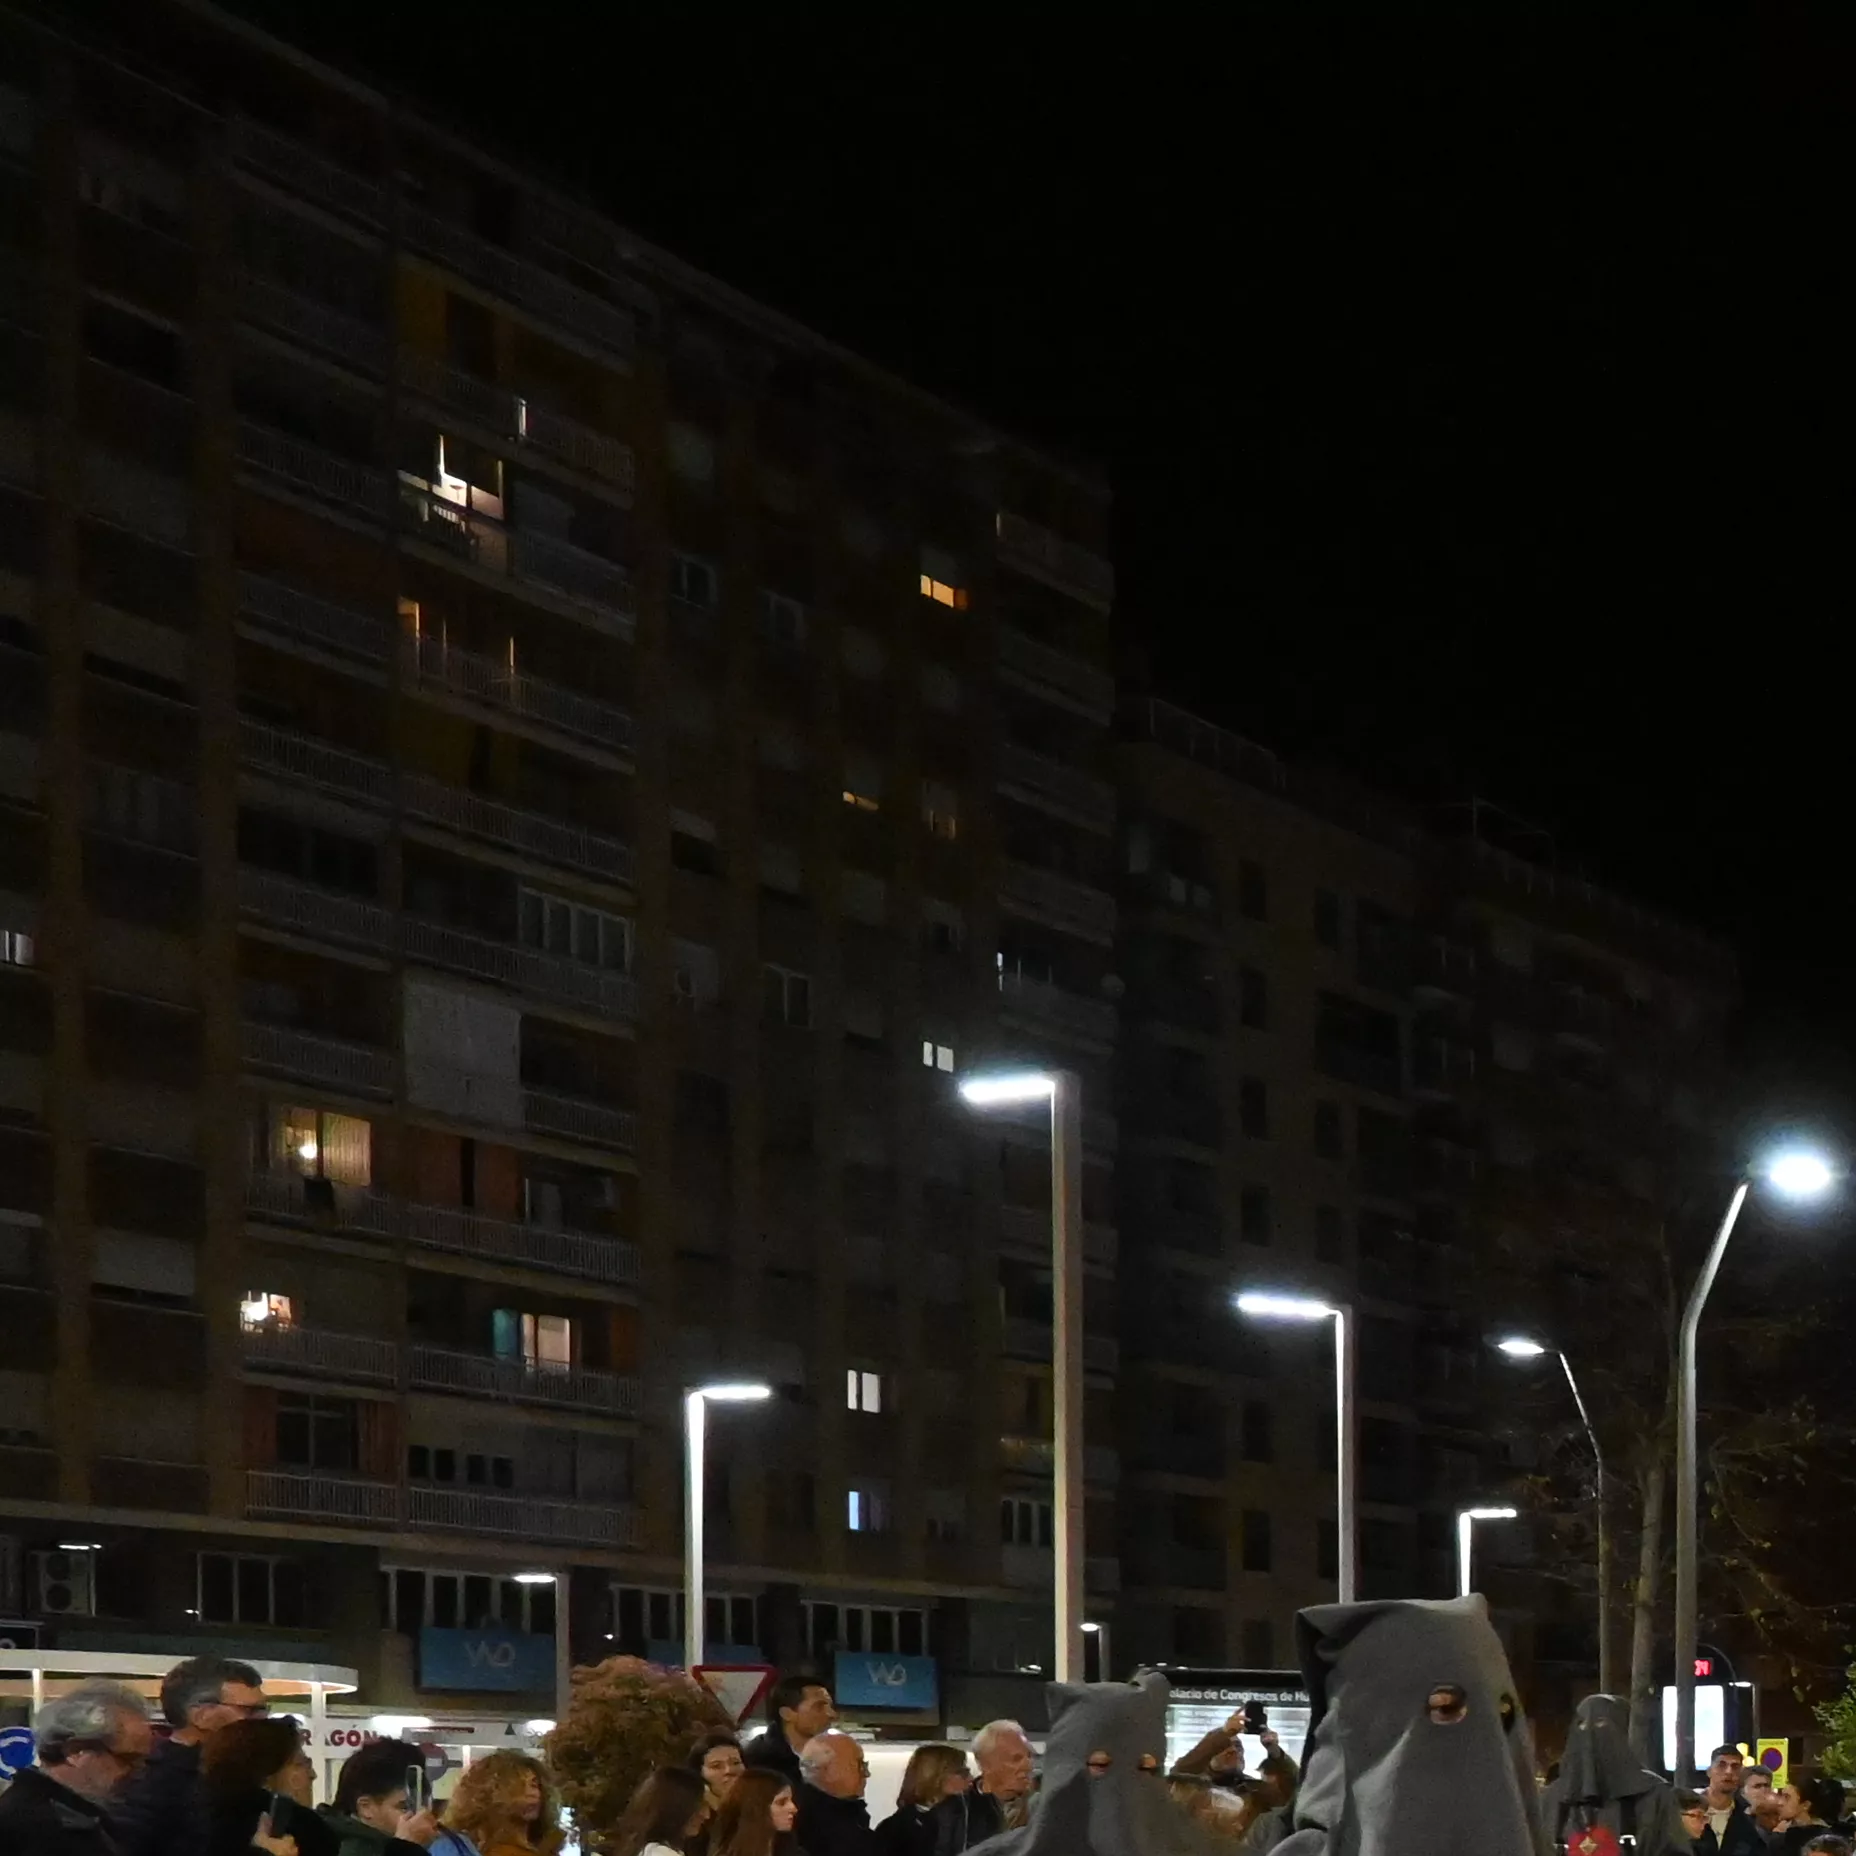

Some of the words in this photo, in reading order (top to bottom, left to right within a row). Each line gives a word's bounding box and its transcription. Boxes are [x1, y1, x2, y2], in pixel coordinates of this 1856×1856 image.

[1169, 1688, 1202, 1699] alacio
[1203, 1688, 1218, 1700] de
[1279, 1692, 1293, 1702] de
